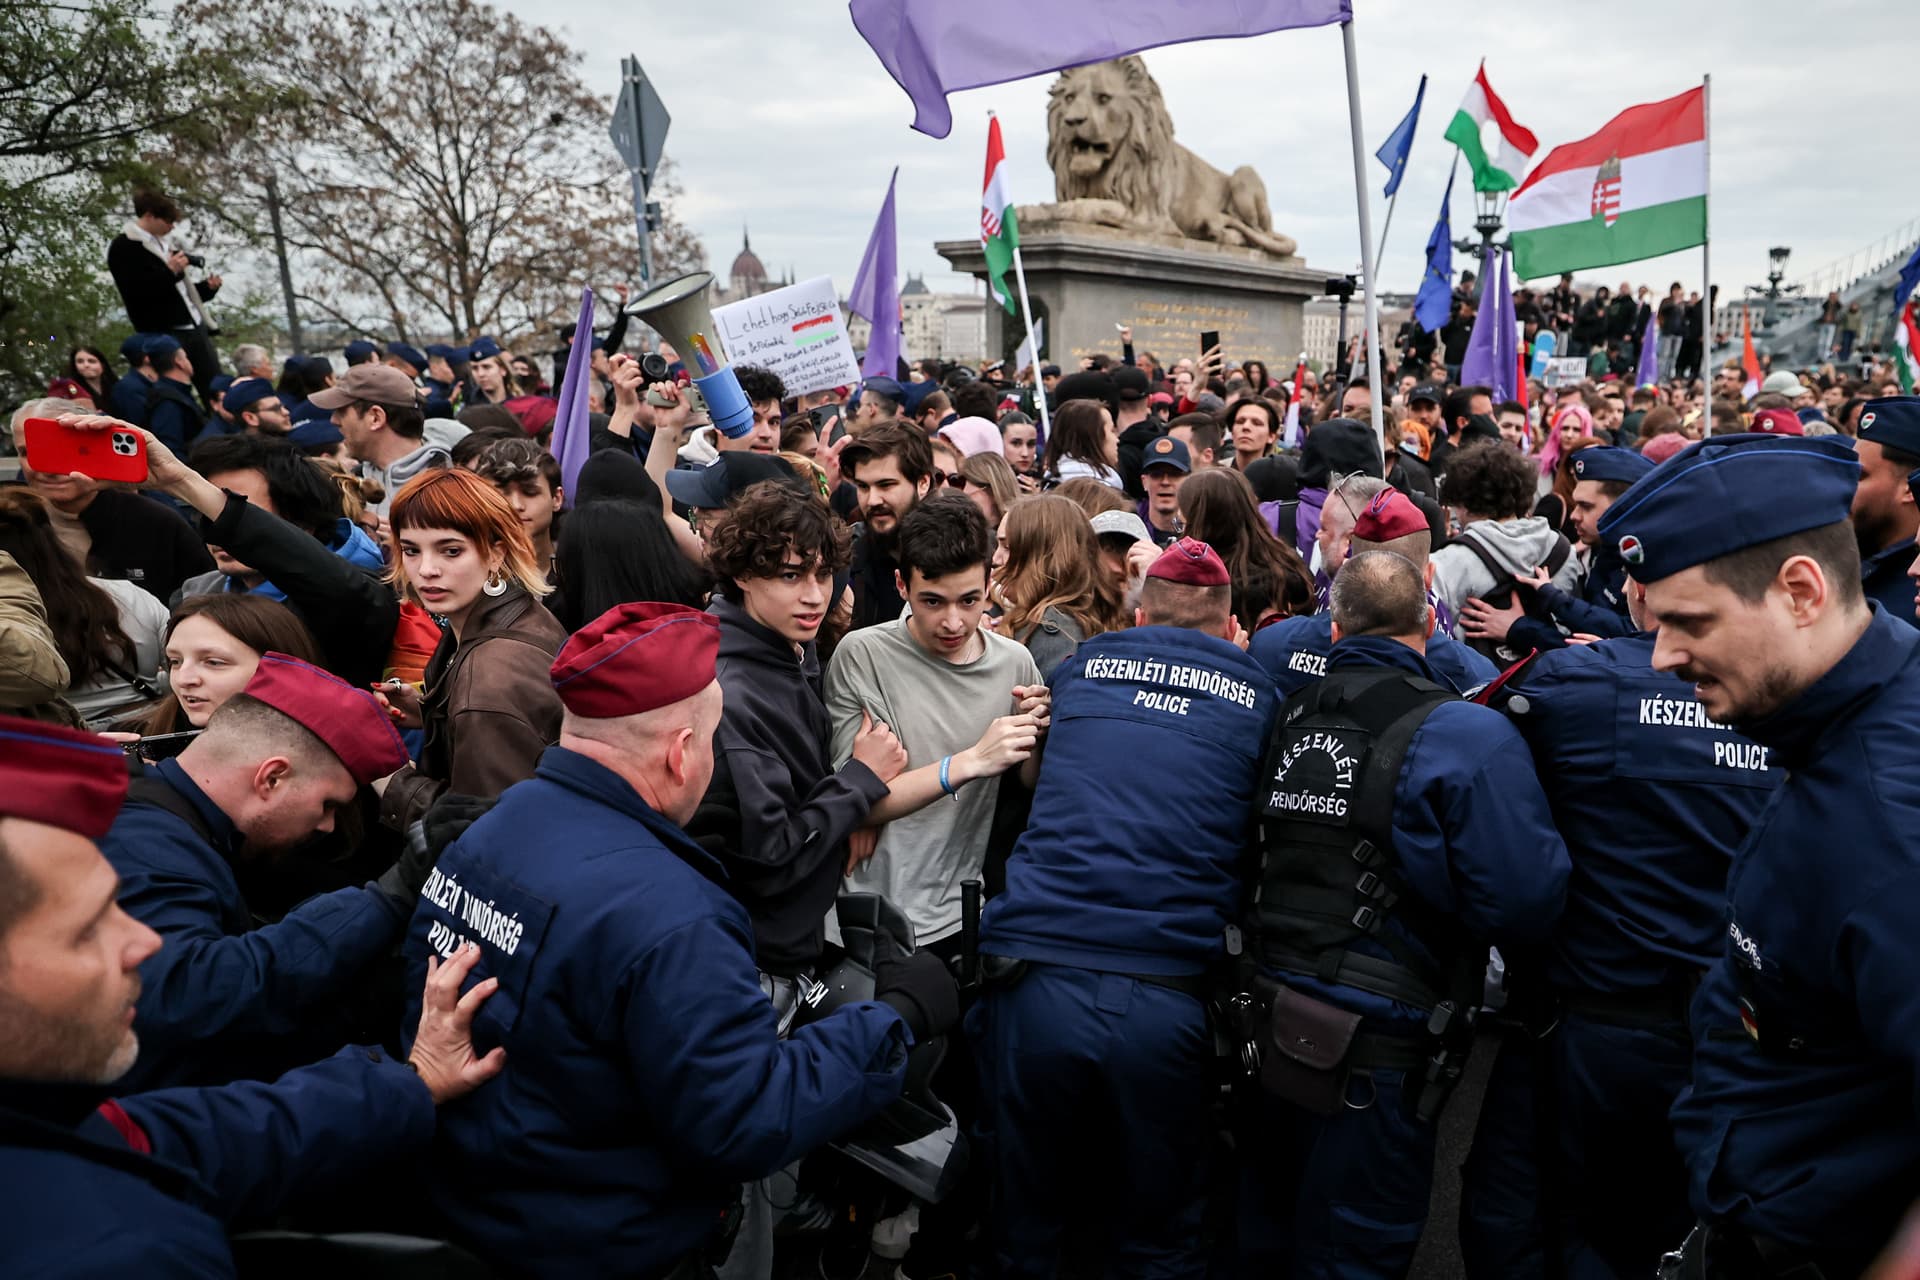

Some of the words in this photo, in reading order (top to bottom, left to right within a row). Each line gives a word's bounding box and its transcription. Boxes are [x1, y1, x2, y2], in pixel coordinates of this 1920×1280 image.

[1288, 648, 1328, 677] KÉSZE
[1085, 654, 1166, 684] KÉSZENLÉTI
[1168, 665, 1256, 709] RENDŐRSÉG
[1133, 690, 1191, 716] POLICE
[1639, 693, 1733, 731] KÉSZEN
[1274, 733, 1358, 788] KÉSZENLÉTI
[1714, 741, 1769, 771] POLICE
[1269, 789, 1347, 816] RENDŐRSÉG
